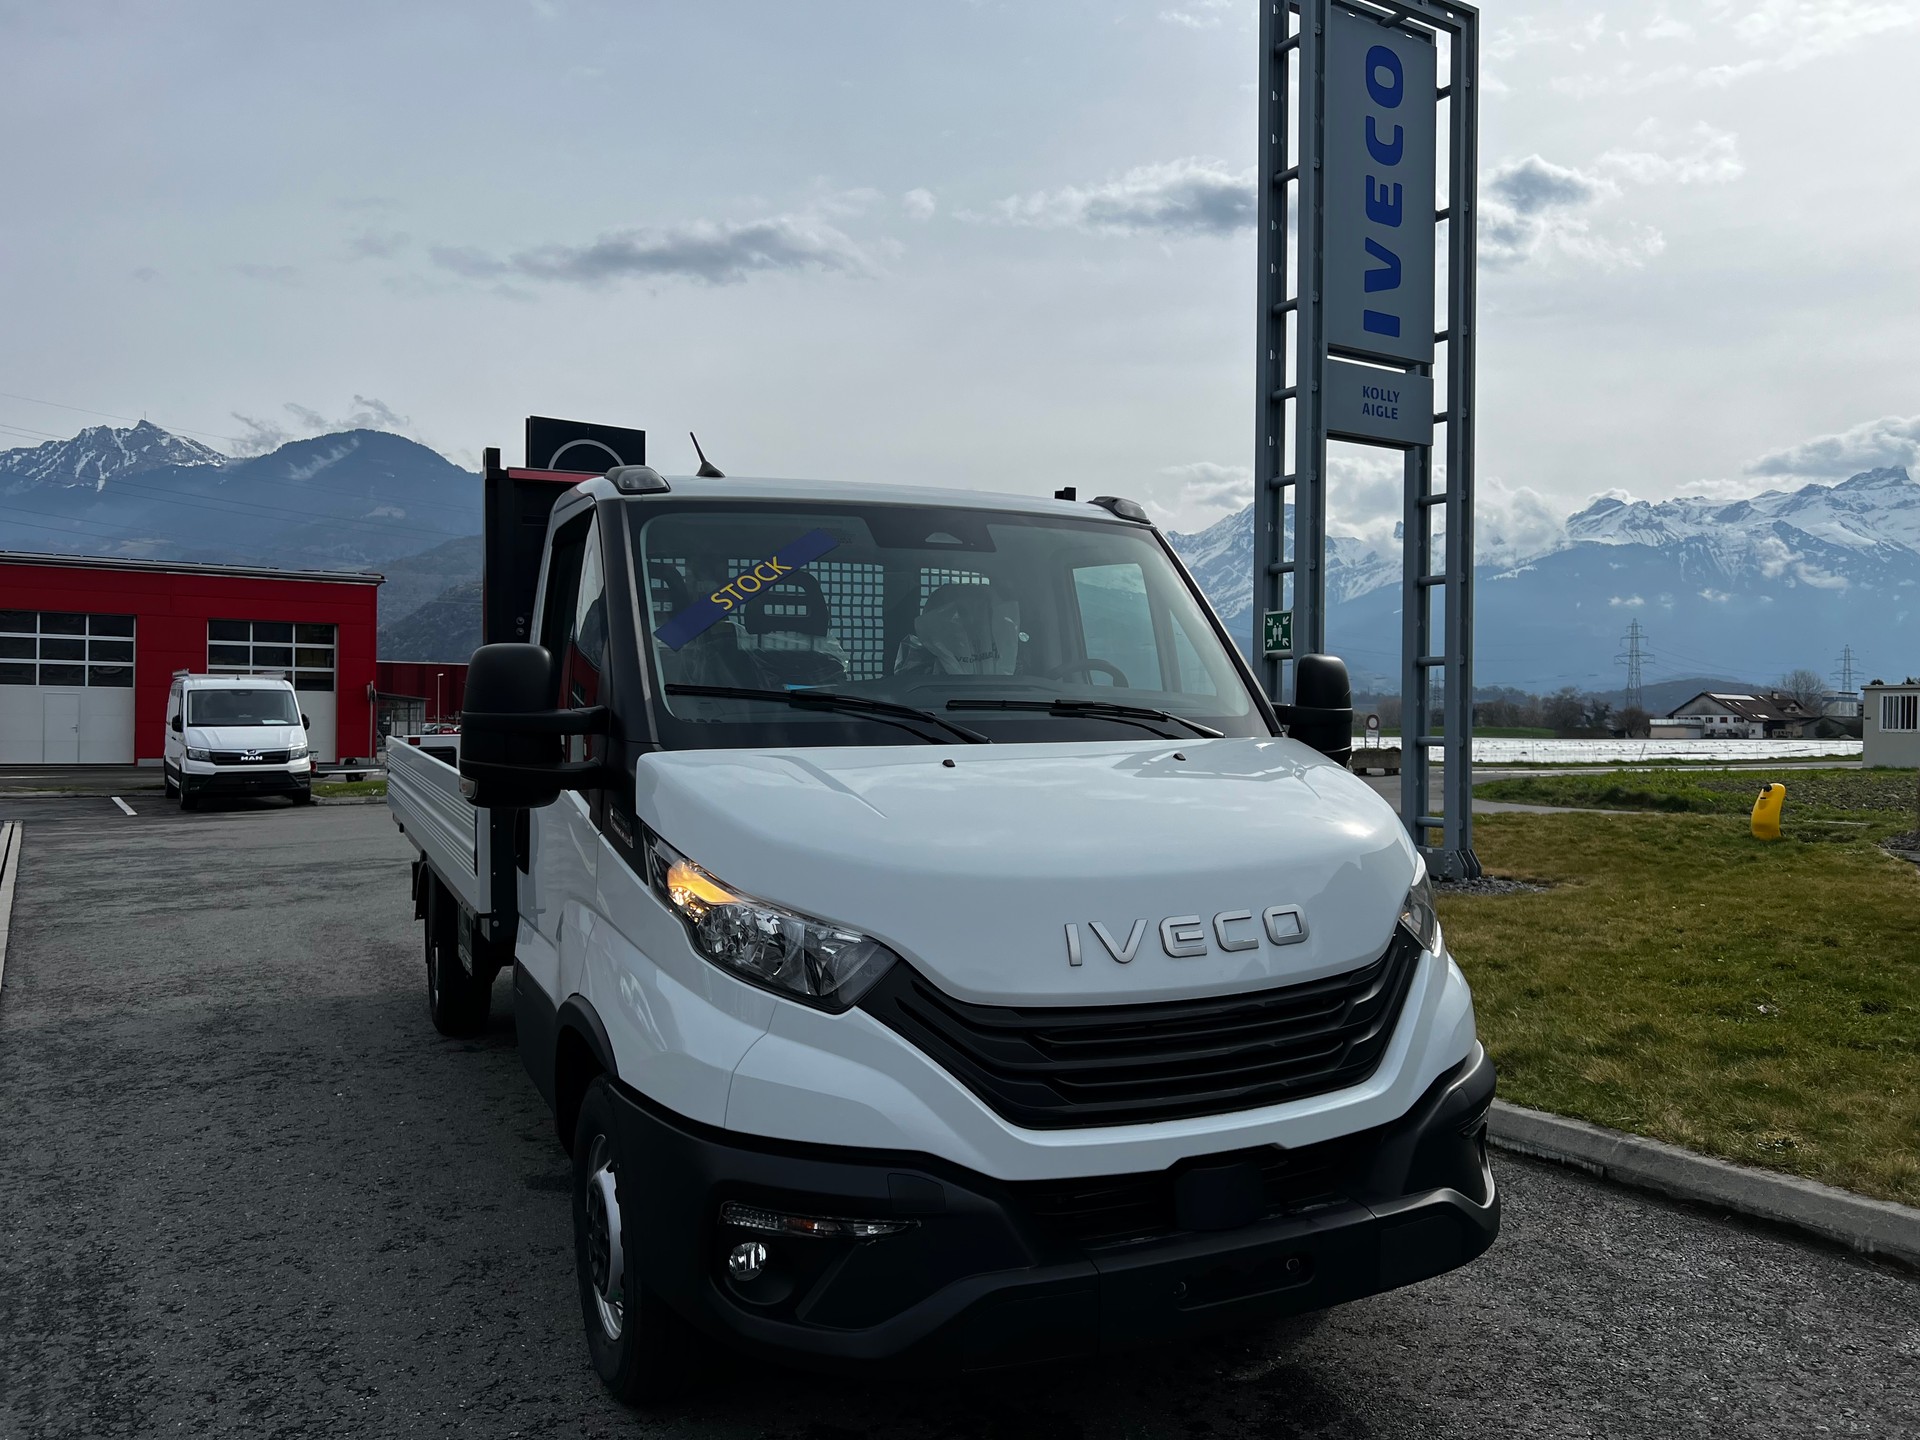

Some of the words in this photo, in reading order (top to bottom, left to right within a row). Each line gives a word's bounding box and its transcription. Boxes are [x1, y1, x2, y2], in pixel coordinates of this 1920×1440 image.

[1363, 45, 1404, 338] IVECO
[1362, 385, 1400, 404] KOLLY
[1362, 402, 1399, 420] AIGLE
[710, 556, 793, 611] STOCK
[1064, 903, 1311, 967] IVECO
